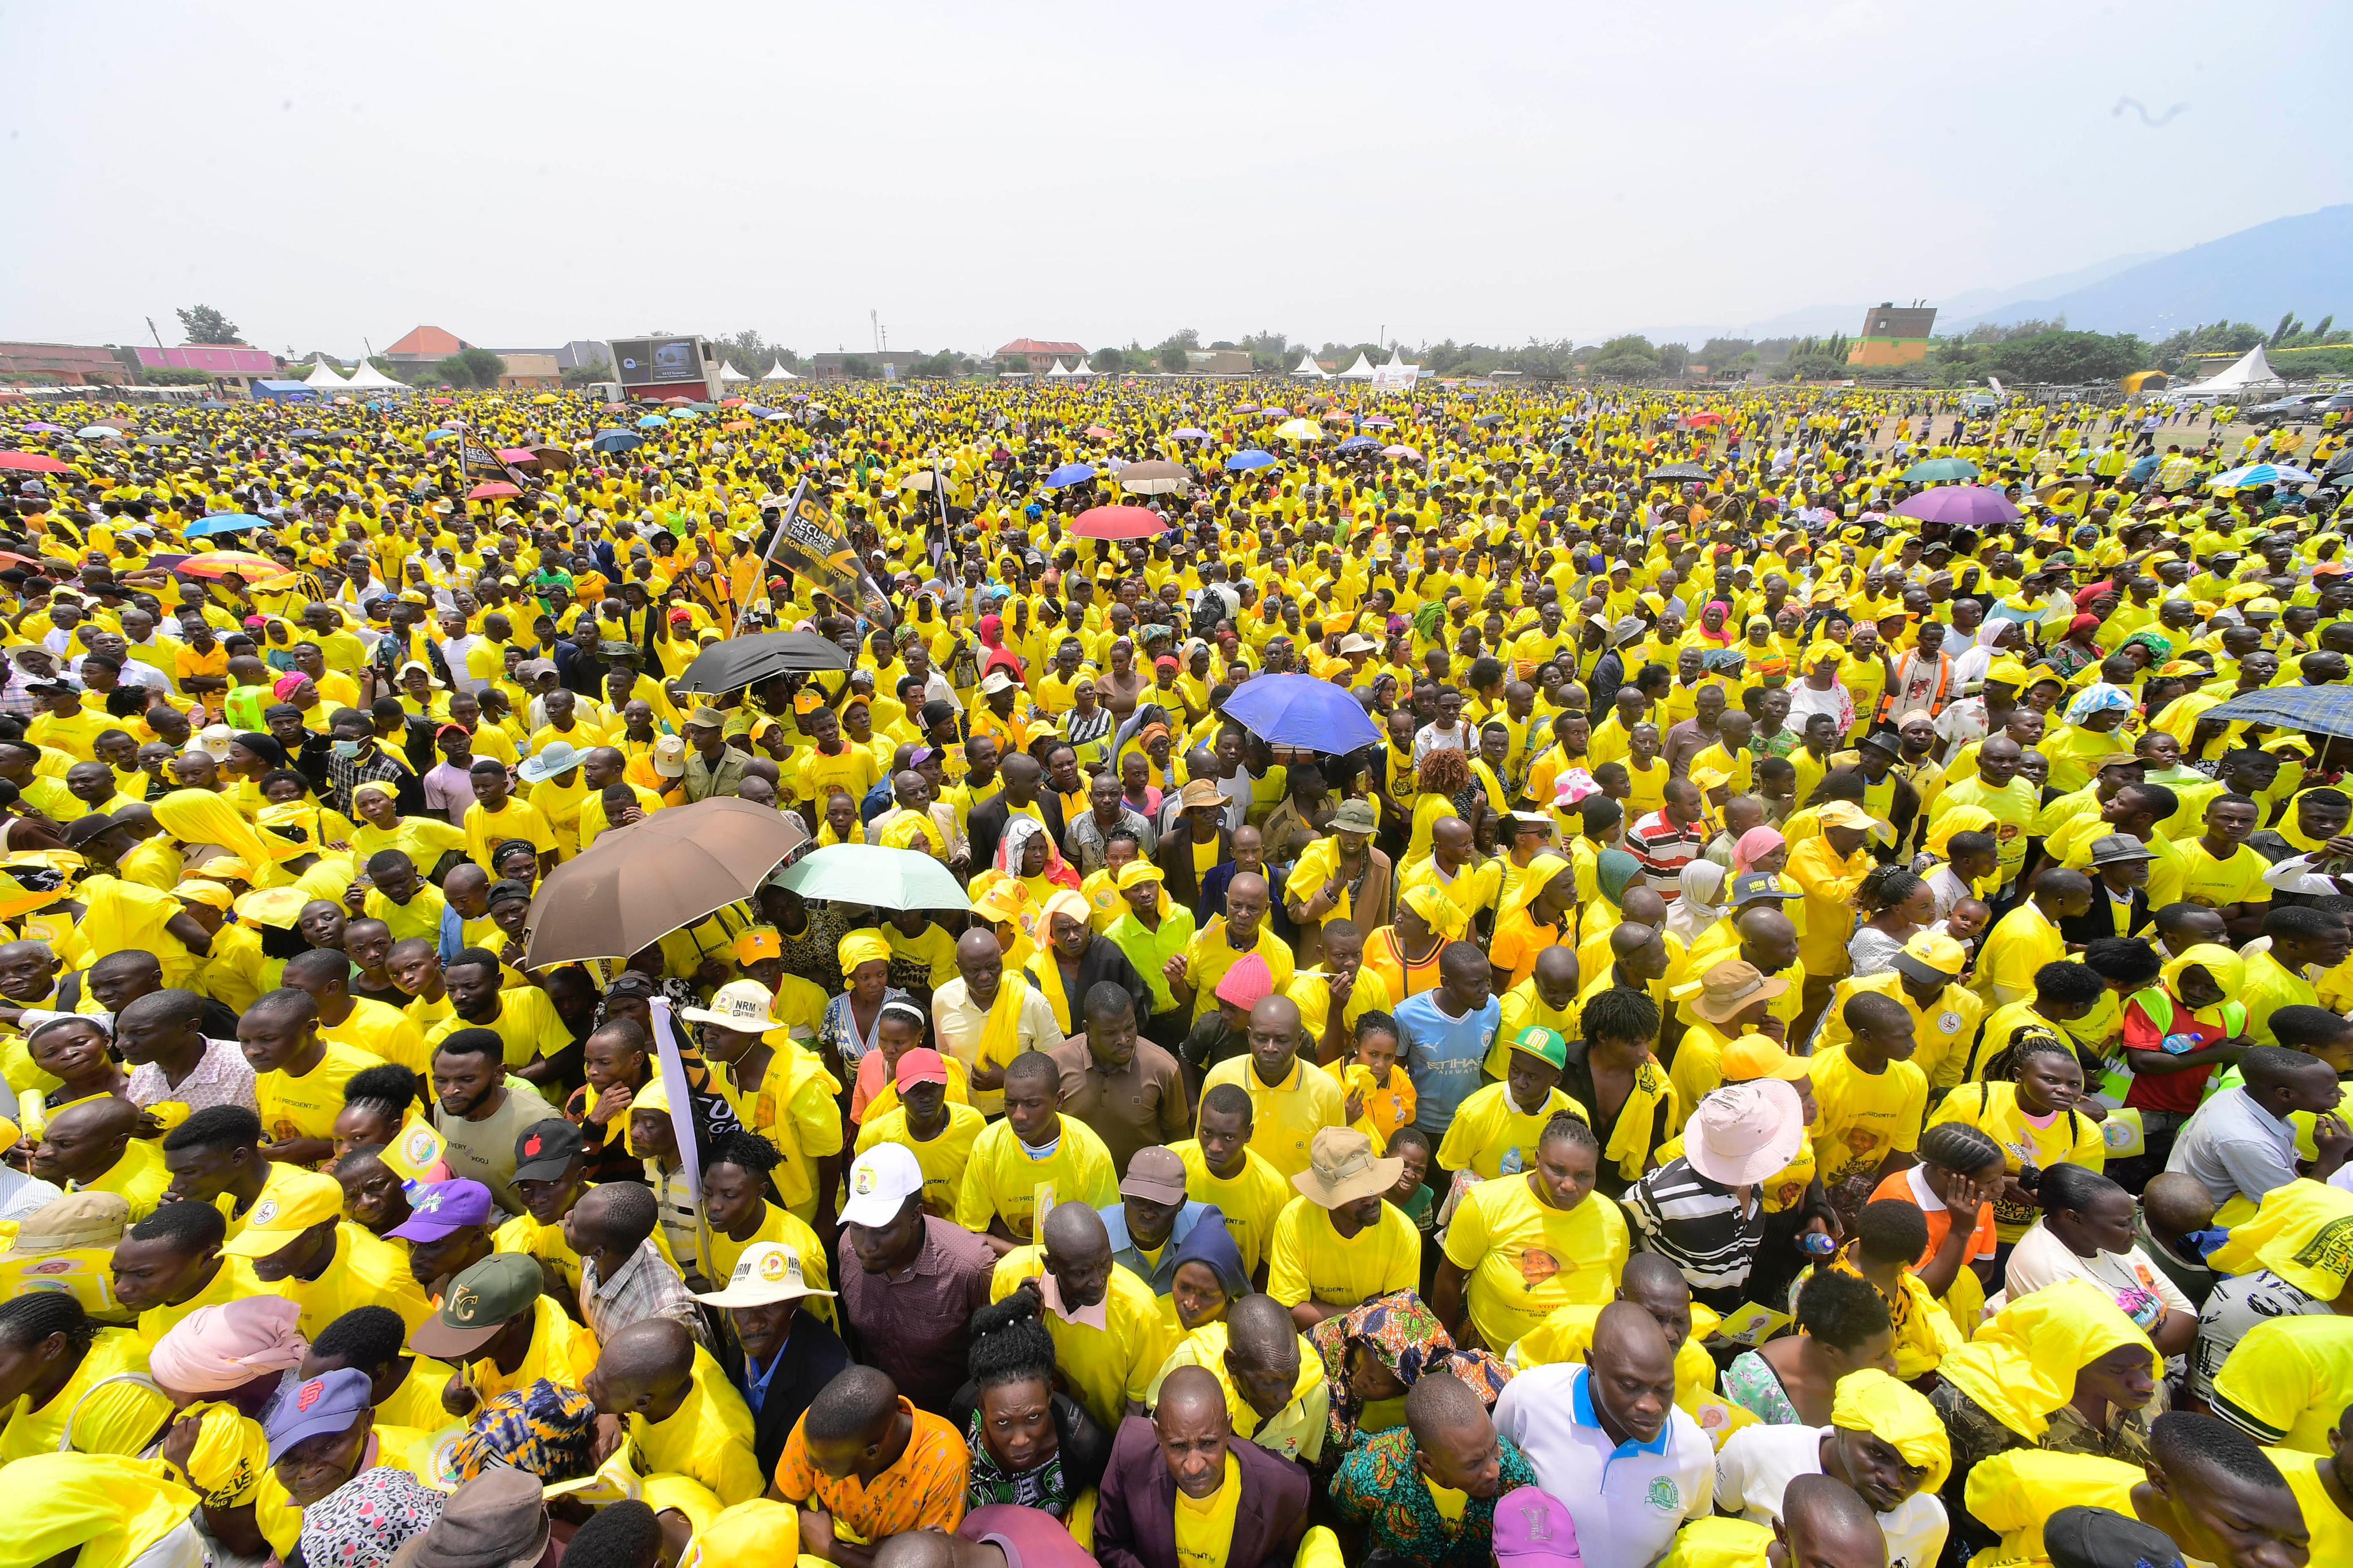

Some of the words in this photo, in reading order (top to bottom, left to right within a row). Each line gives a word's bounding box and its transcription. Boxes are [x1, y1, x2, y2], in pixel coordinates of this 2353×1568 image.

[466, 448, 489, 457] SECU
[799, 499, 842, 540] GEN
[793, 516, 836, 550] SECURE
[790, 525, 805, 538] THE
[804, 534, 831, 555] LEGACY
[783, 537, 800, 551] FOR
[800, 547, 848, 582] GENERATION
[1749, 880, 1766, 890] NRM
[897, 950, 920, 961] PRESIDENT
[1916, 951, 1929, 959] NRM
[735, 1000, 757, 1013] NRM
[1438, 1066, 1478, 1076] AIRWAYS
[281, 1098, 312, 1109] PRESIDENT
[448, 1141, 466, 1150] EVERY
[923, 1178, 946, 1187] SIDENT
[1995, 1199, 2035, 1213] OWERI
[1993, 1206, 2036, 1220] SEVENI
[37, 1251, 71, 1259] PRESIDENT
[2321, 1230, 2353, 1271] SEVENI
[449, 1283, 479, 1322] KC
[1176, 1547, 1209, 1560] SIDENT
